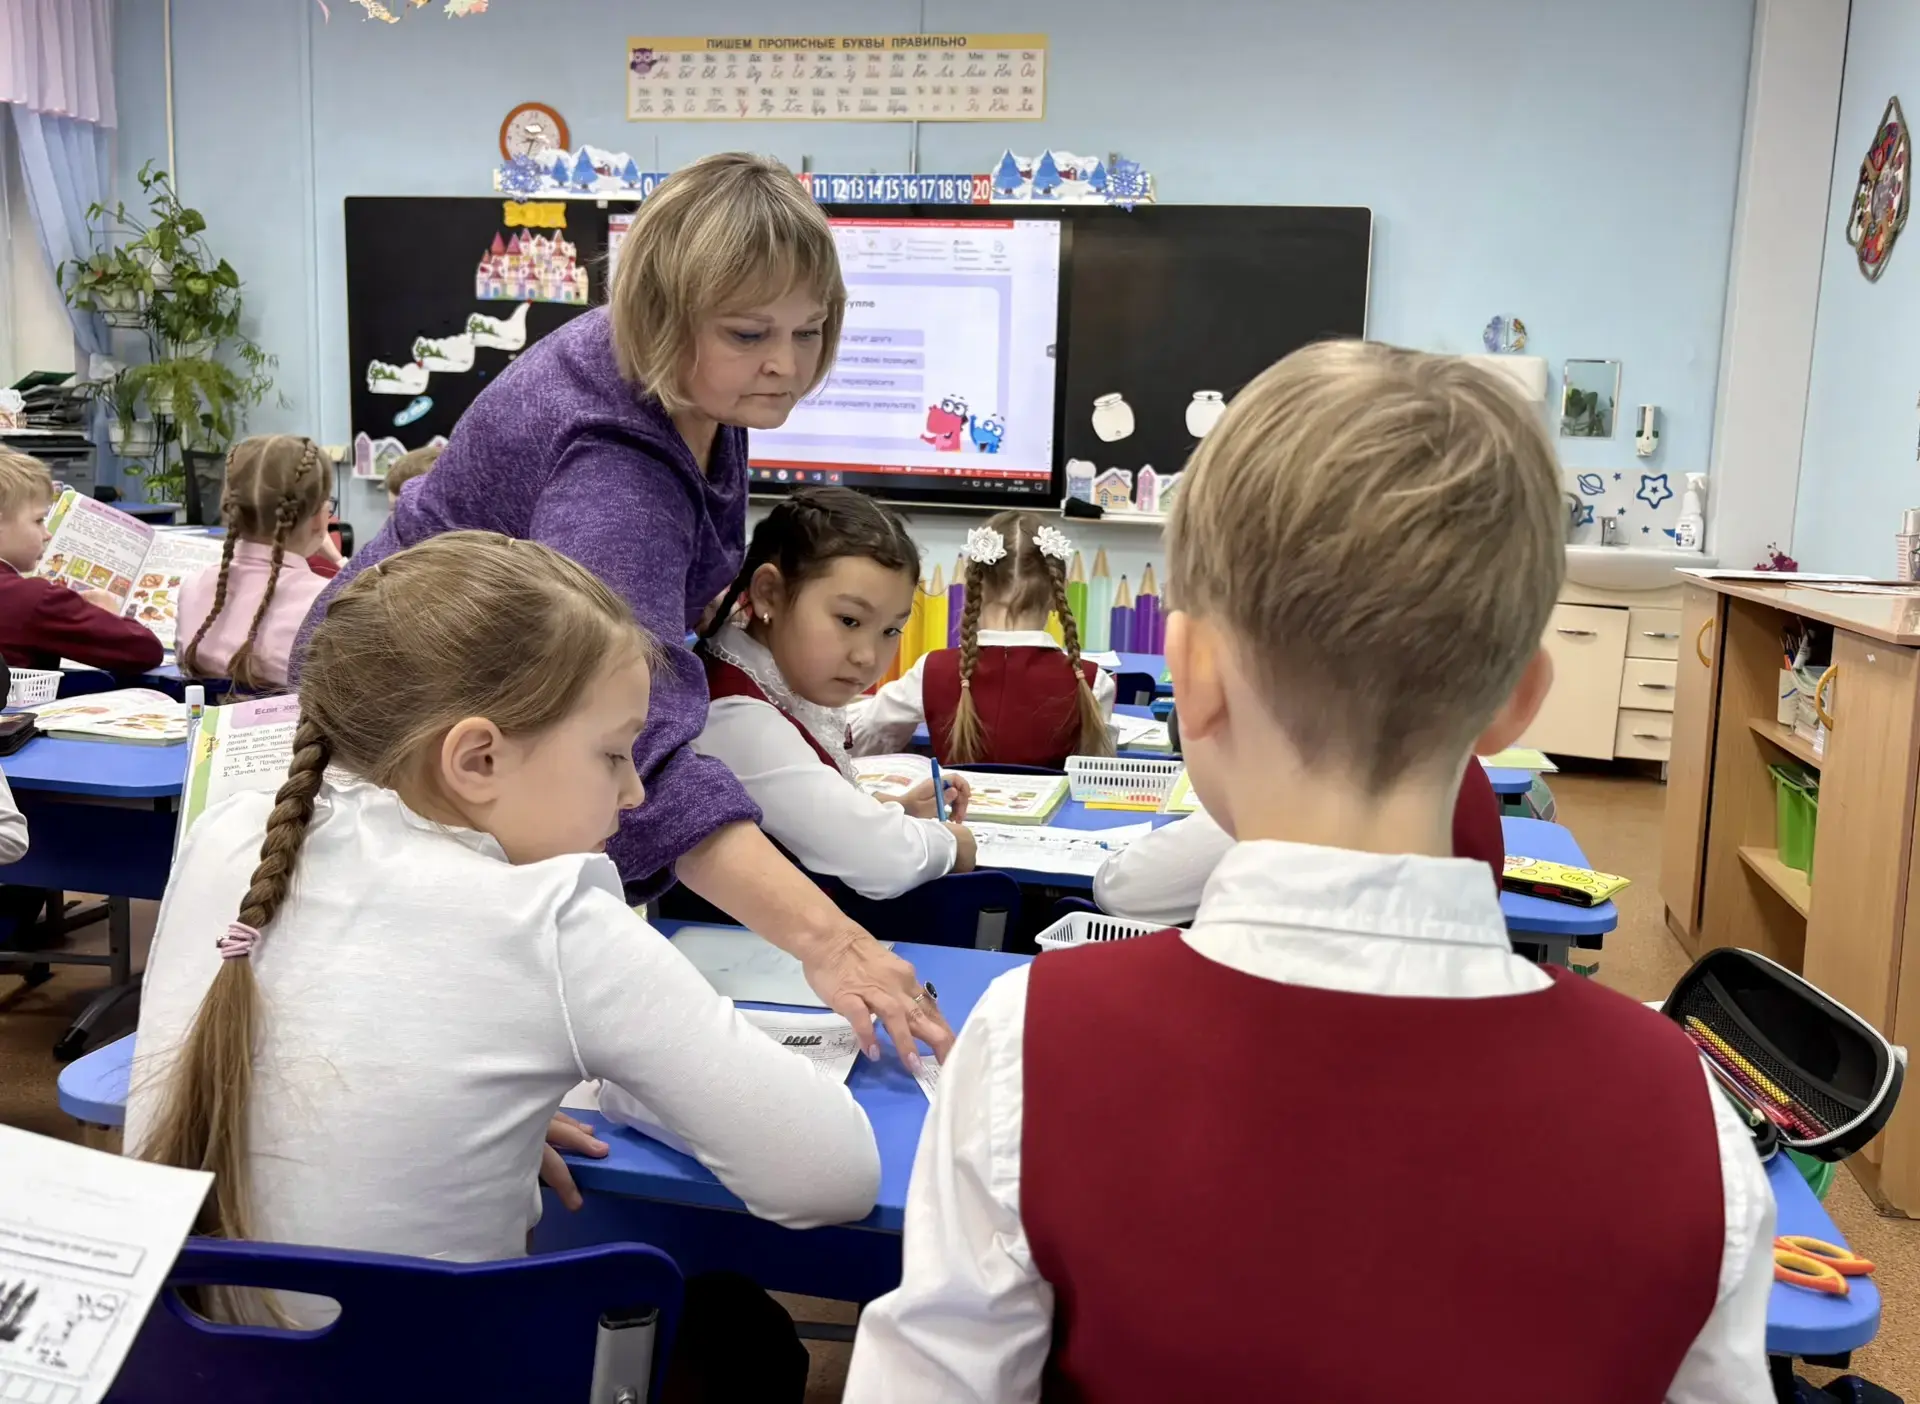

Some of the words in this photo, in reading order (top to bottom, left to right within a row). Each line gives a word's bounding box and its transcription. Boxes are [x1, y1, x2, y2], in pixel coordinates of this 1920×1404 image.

[706, 38, 752, 50] ПИШЕМ
[759, 38, 836, 50] ПРОПИСНЫЕ
[842, 37, 885, 49] БУКВЫ
[892, 36, 967, 49] ПРАВИЛЬНО
[643, 177, 654, 196] 0
[814, 178, 828, 199] 11
[831, 178, 847, 199] 12
[850, 178, 864, 199] 13
[867, 178, 881, 199] 14
[885, 178, 899, 199] 15
[903, 179, 918, 199] 16
[920, 179, 935, 199] 17
[938, 179, 953, 199] 18
[956, 179, 972, 200] 19
[973, 179, 990, 200] 20
[254, 707, 278, 715] Если
